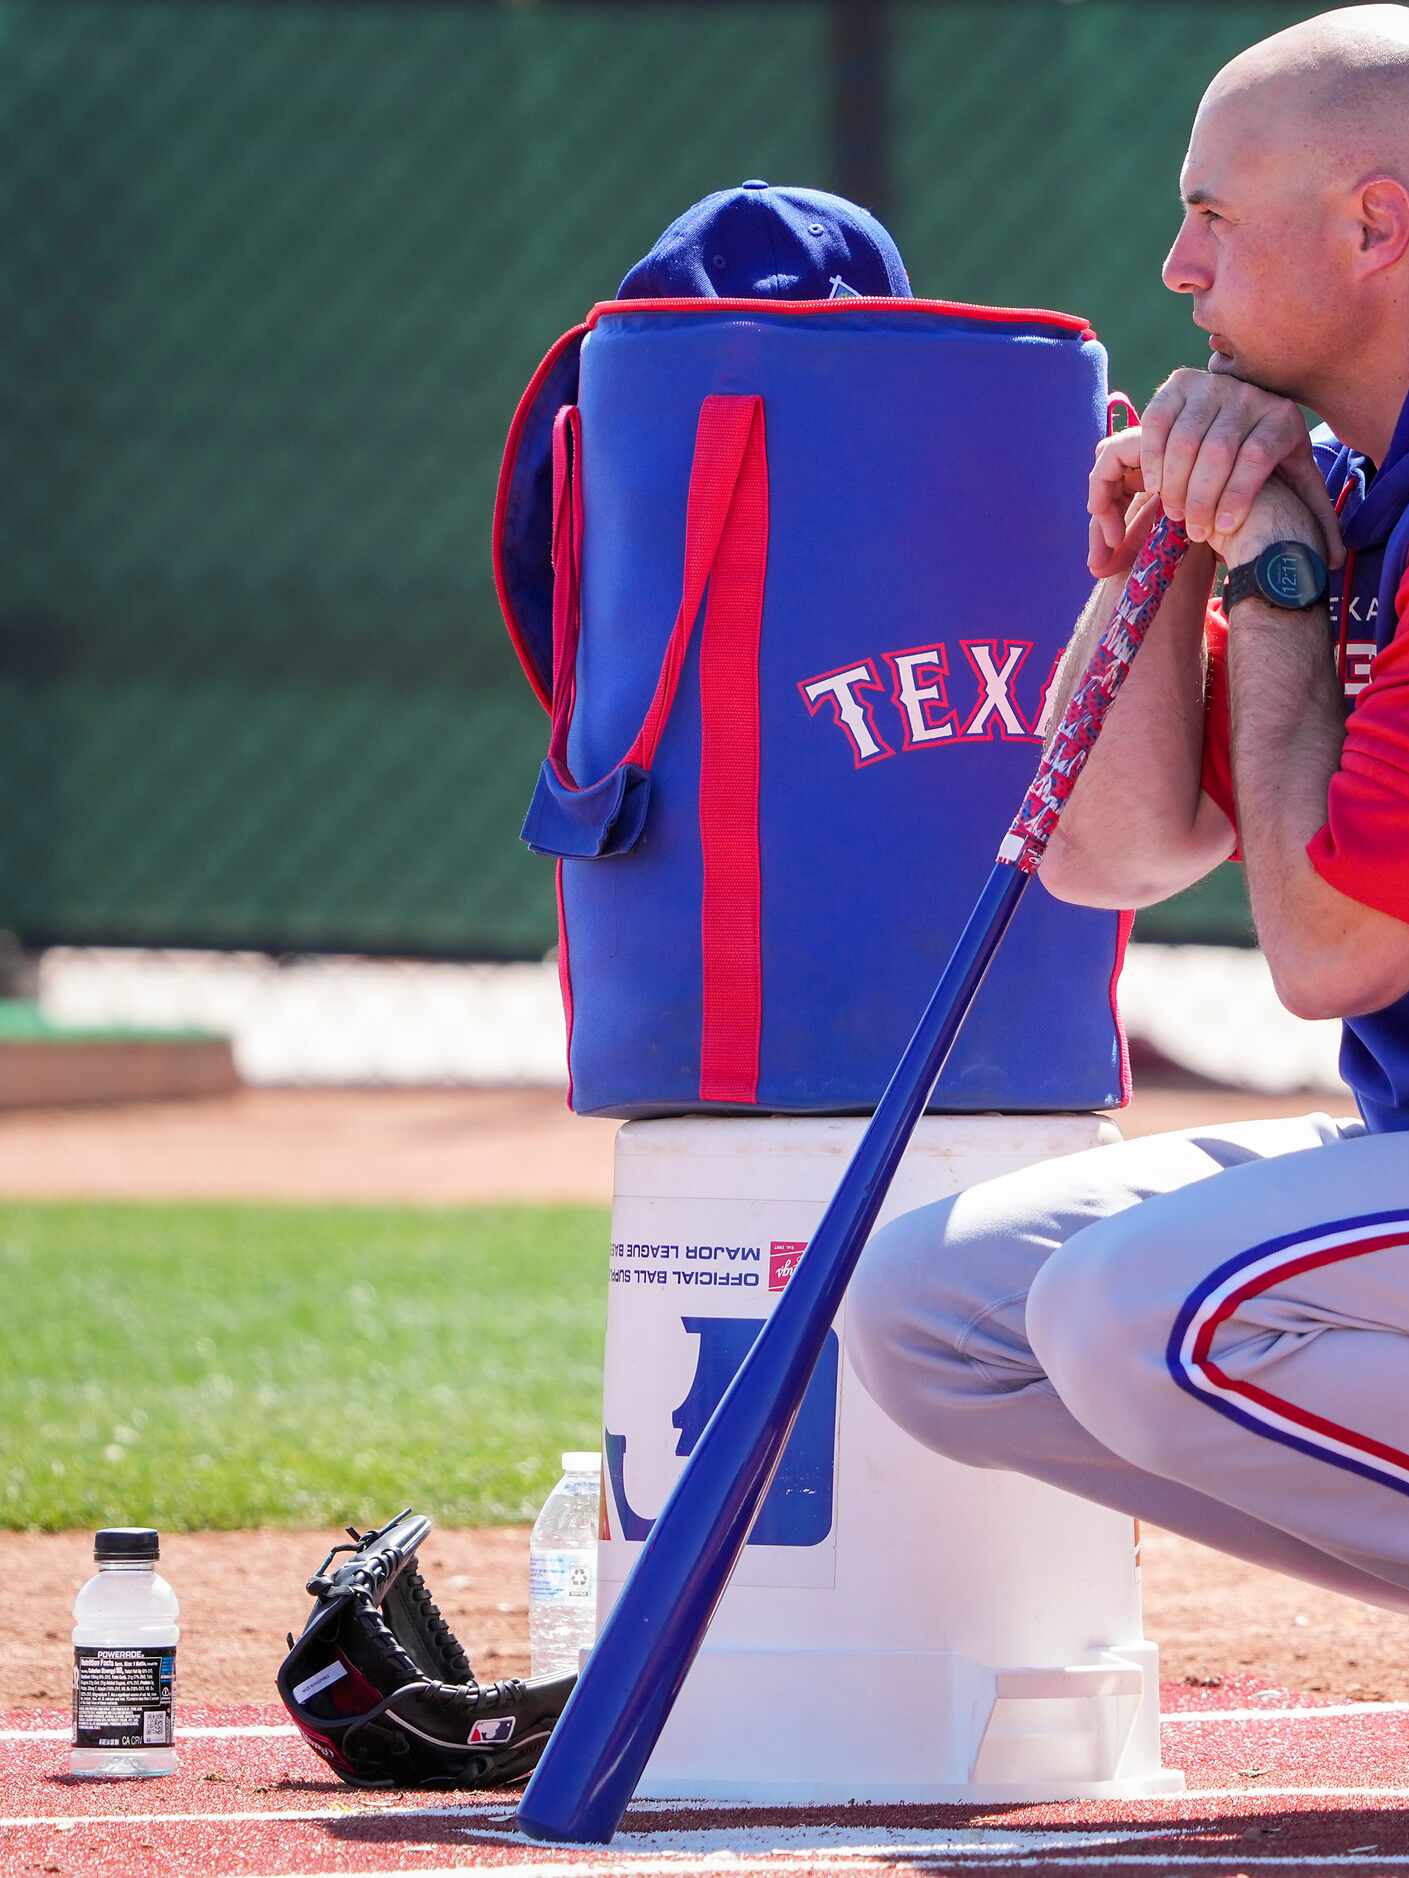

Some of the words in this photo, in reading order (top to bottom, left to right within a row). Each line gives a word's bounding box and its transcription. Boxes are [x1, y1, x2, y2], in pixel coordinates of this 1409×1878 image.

[627, 1244, 679, 1259] LEAGUE
[685, 1246, 761, 1261] MAJOR
[634, 1270, 668, 1285] BALL
[672, 1271, 760, 1286] OFFICIAL
[97, 1651, 141, 1659] POWERADE
[121, 1736, 130, 1745] CA
